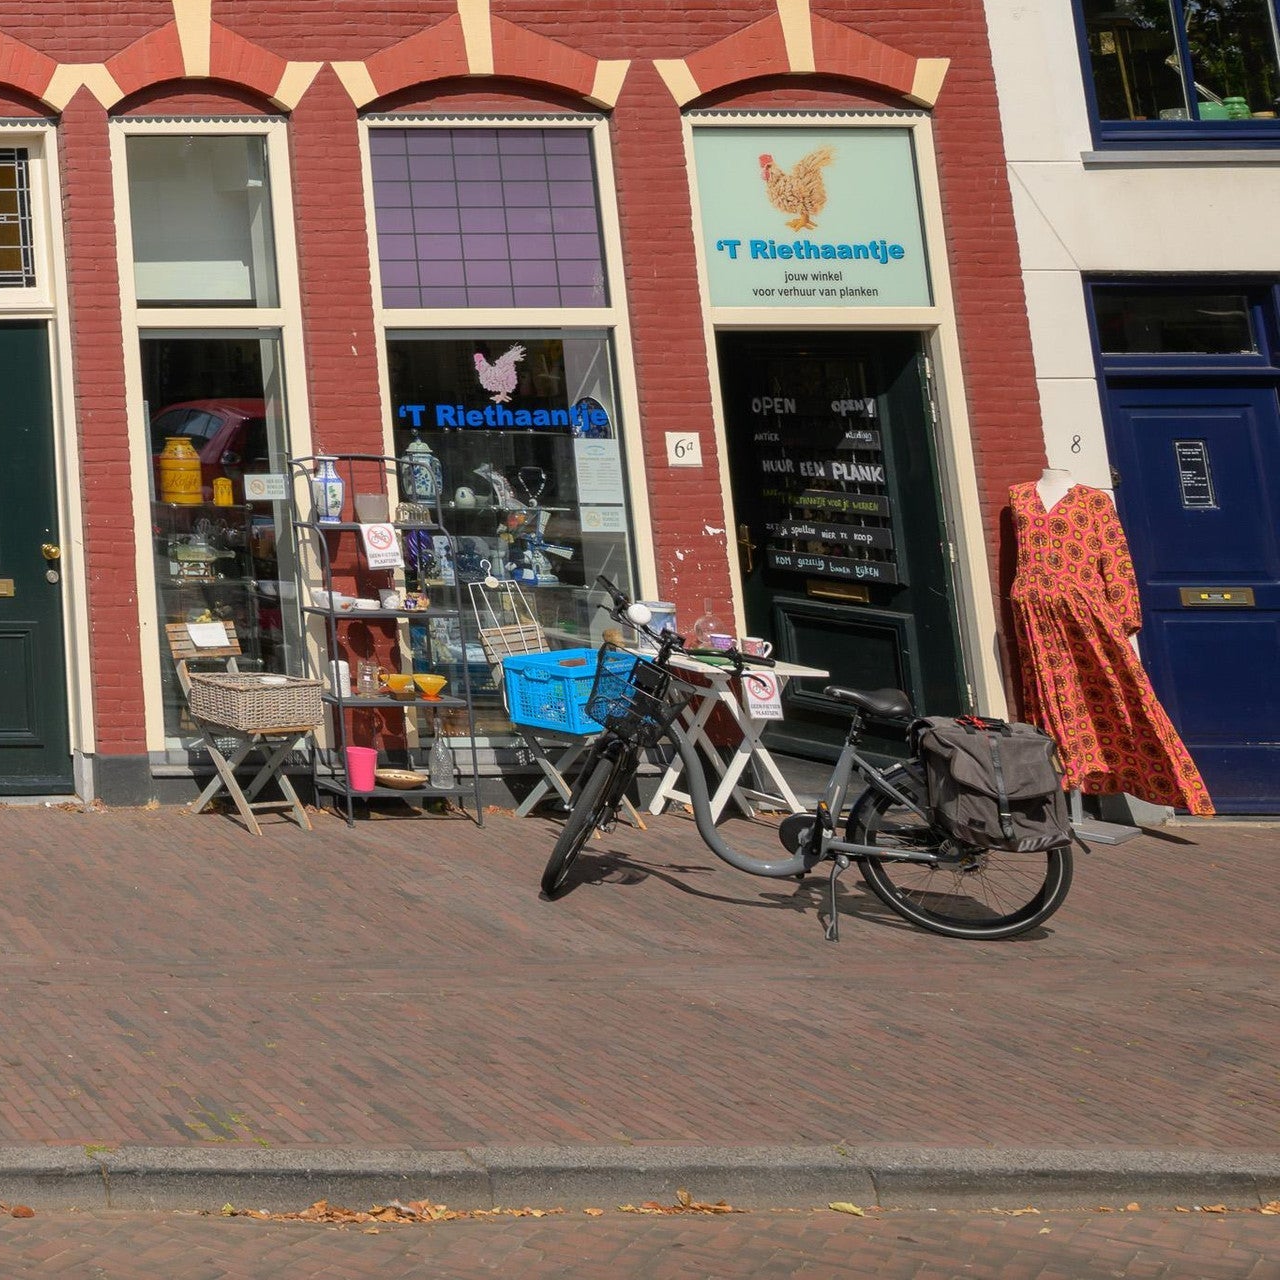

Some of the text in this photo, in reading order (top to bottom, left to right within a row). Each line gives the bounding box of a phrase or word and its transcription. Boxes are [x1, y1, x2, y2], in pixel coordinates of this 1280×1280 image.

[750, 239, 906, 265] Riethaantje
[784, 271, 843, 283] jouw winkel
[752, 286, 879, 299] voor verhuur van planken
[752, 397, 797, 416] OPEN
[436, 404, 609, 432] Riethaantje
[1071, 434, 1081, 454] 8
[762, 459, 884, 483] HUUR EEN PLANK
